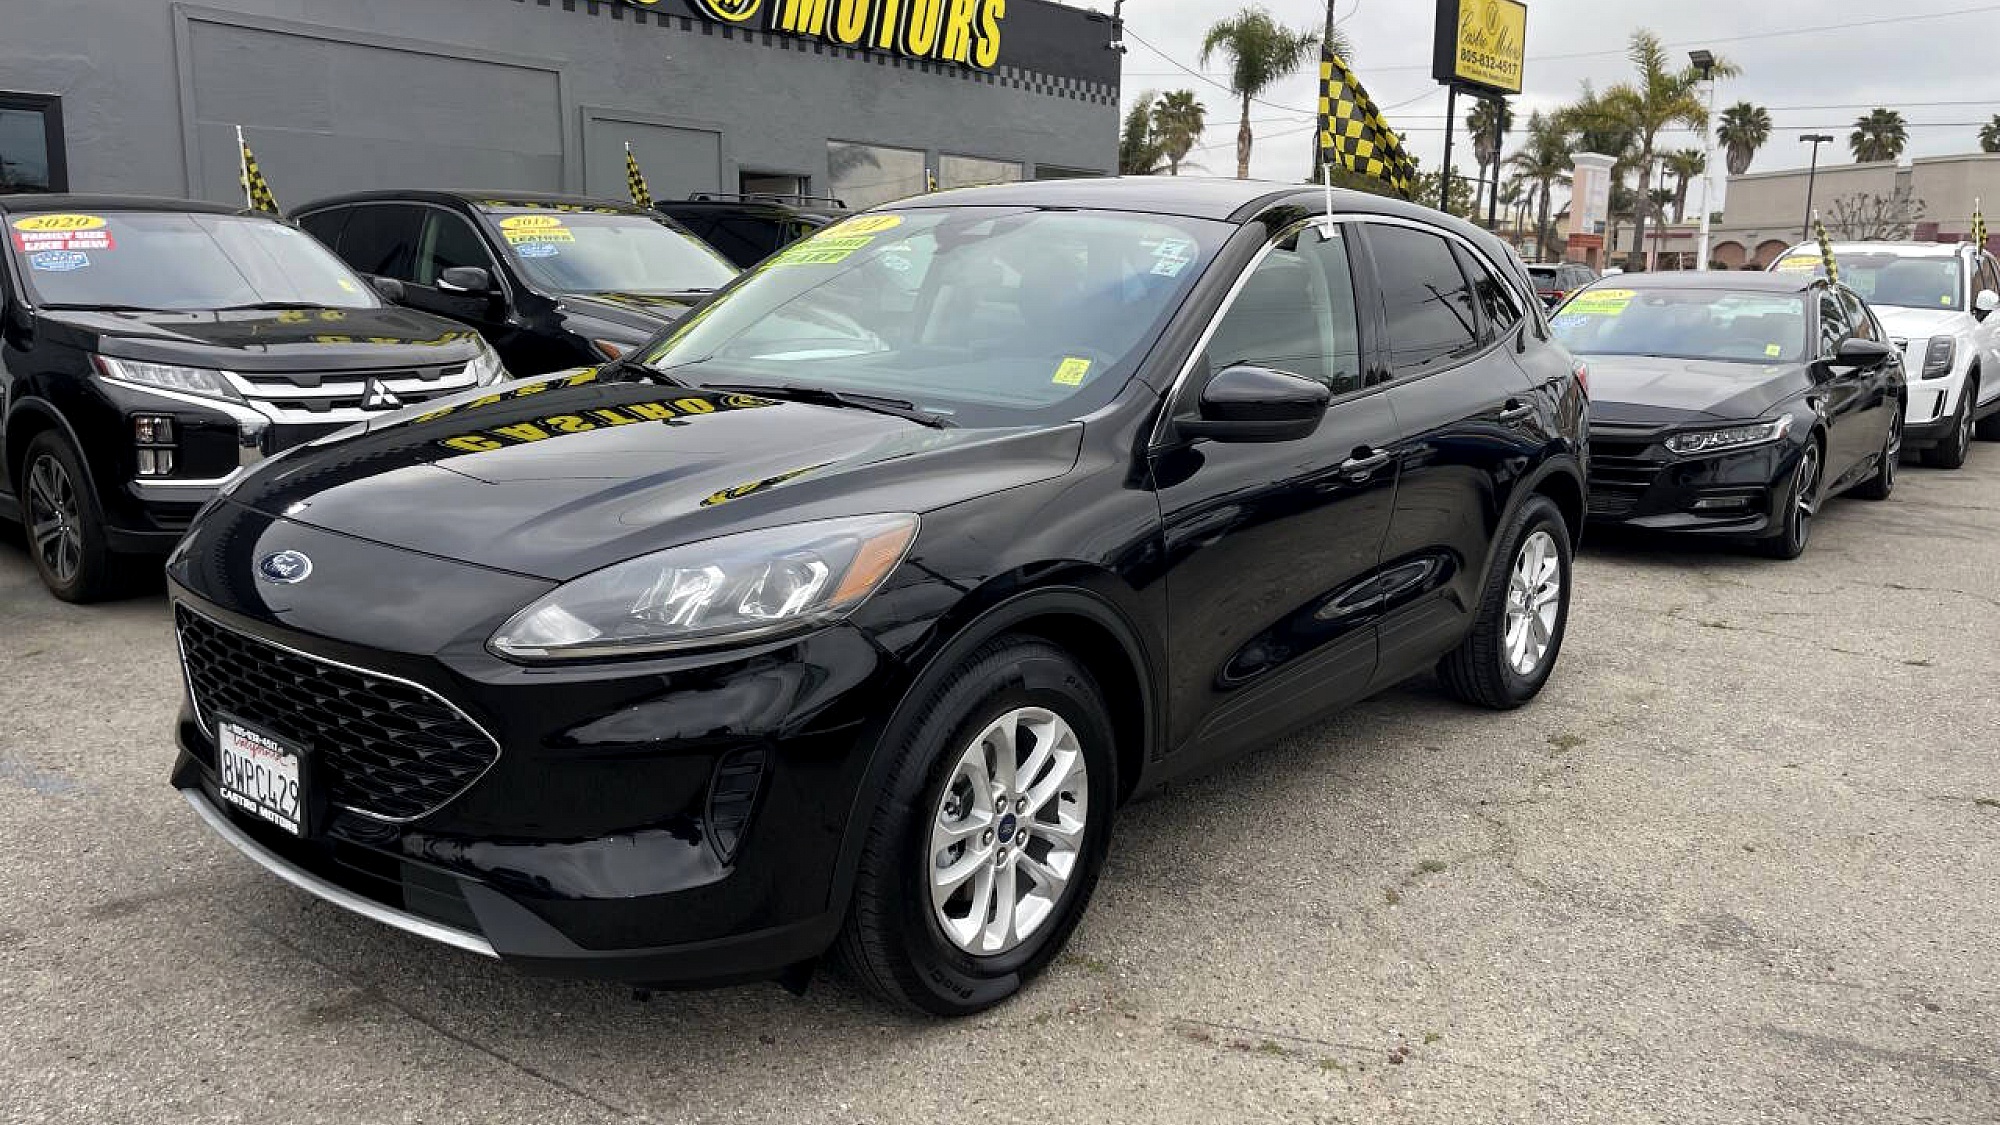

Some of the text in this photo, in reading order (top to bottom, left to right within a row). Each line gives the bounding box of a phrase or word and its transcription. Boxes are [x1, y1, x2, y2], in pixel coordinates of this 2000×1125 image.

[29, 217, 90, 229] 2020
[21, 232, 74, 242] FAMILY
[24, 241, 64, 251] LIKE
[223, 748, 299, 818] 8WPC429
[219, 787, 299, 836] CASTRO MOTORS
